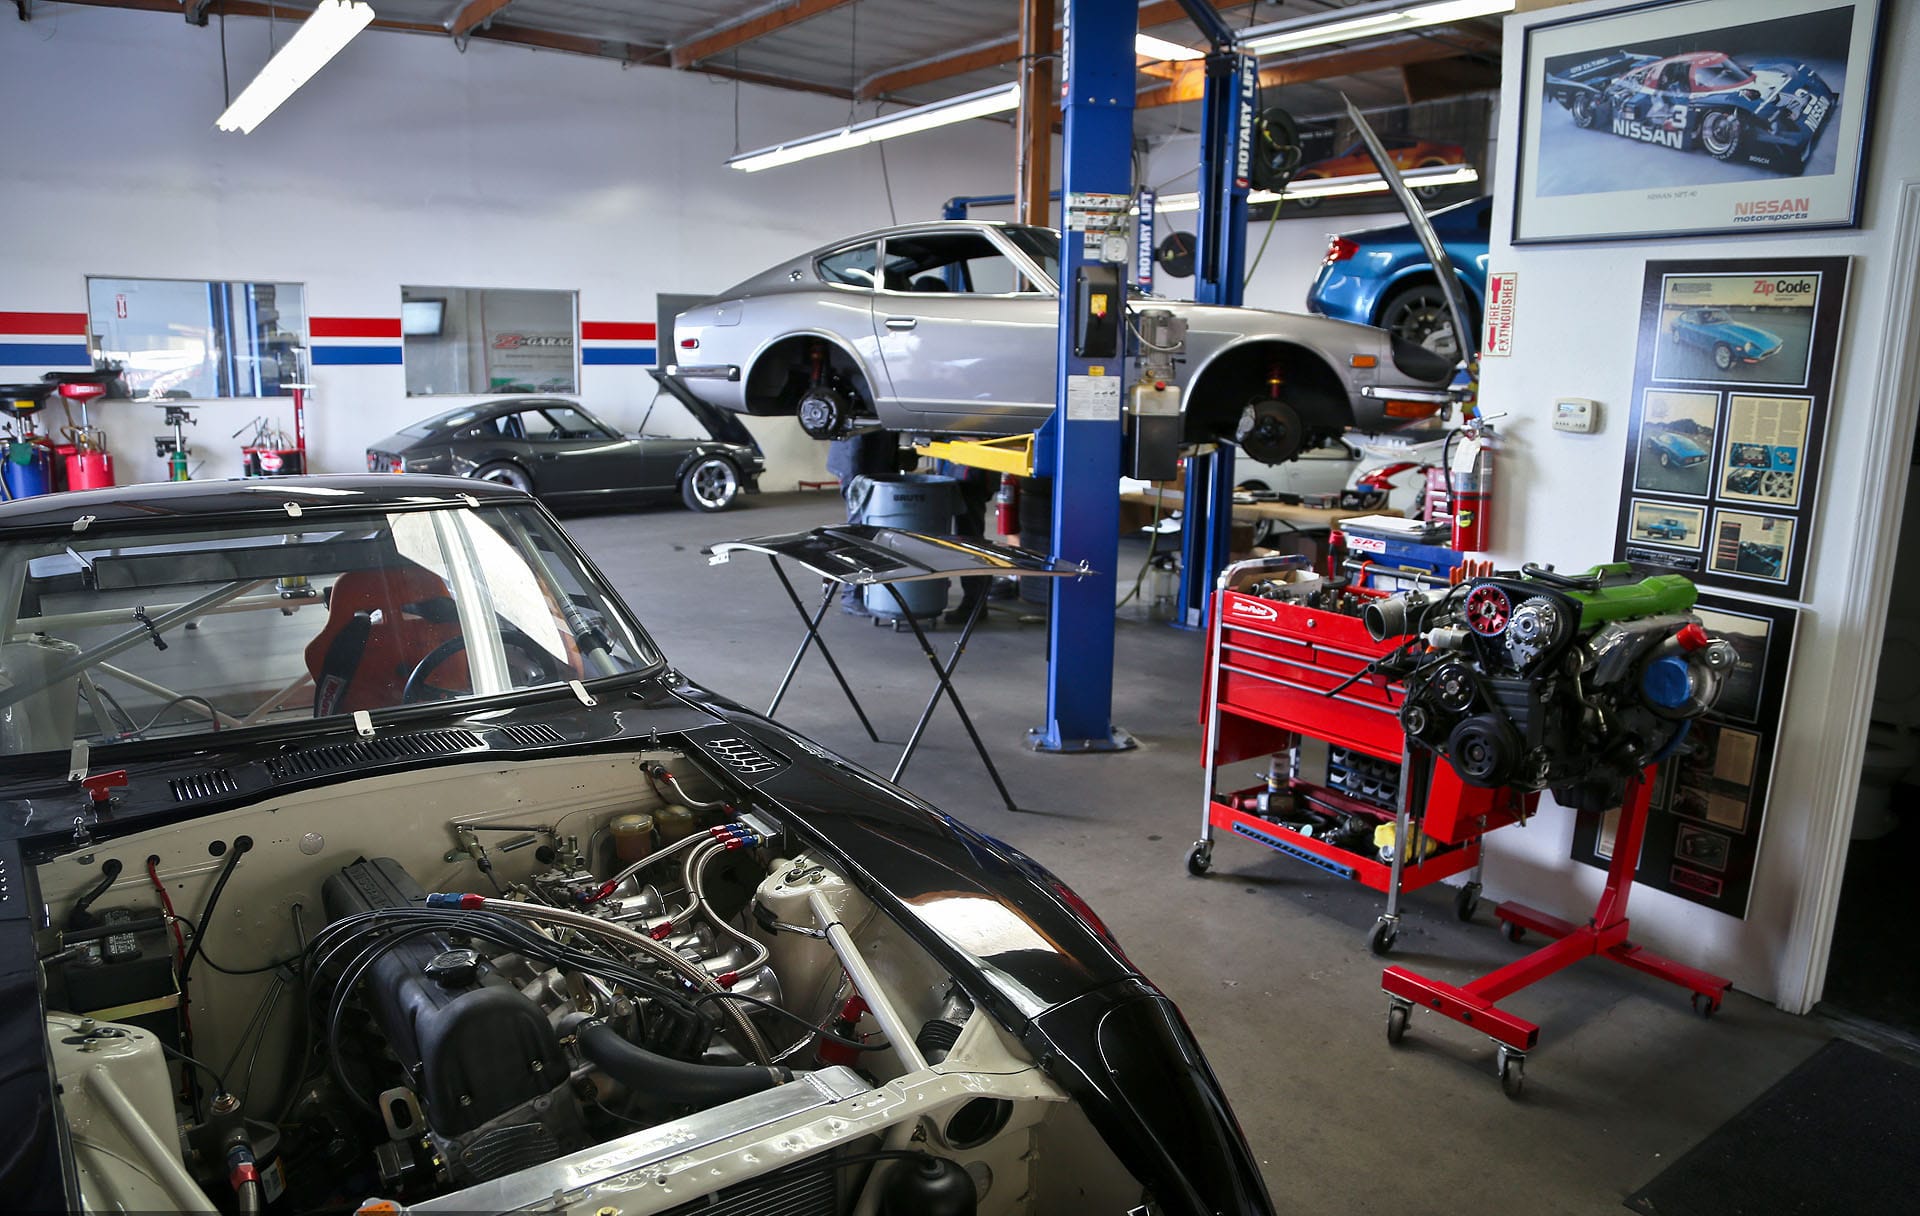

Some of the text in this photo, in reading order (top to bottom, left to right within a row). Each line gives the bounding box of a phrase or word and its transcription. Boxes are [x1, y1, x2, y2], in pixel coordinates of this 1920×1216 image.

[1238, 57, 1255, 177] ROTARY LIFT
[1672, 104, 1688, 129] 3
[1803, 96, 1831, 132] NISSAN
[1612, 118, 1683, 150] NISSAN
[1733, 212, 1808, 223] motorsports
[1734, 199, 1810, 216] NISSAN
[1138, 192, 1152, 277] ROTARY LIFT
[1752, 280, 1776, 297] Zip
[1776, 280, 1811, 294] Code
[1488, 304, 1500, 326] FIRE
[1498, 279, 1514, 352] EXTINGUISHER
[1352, 538, 1385, 548] SPC
